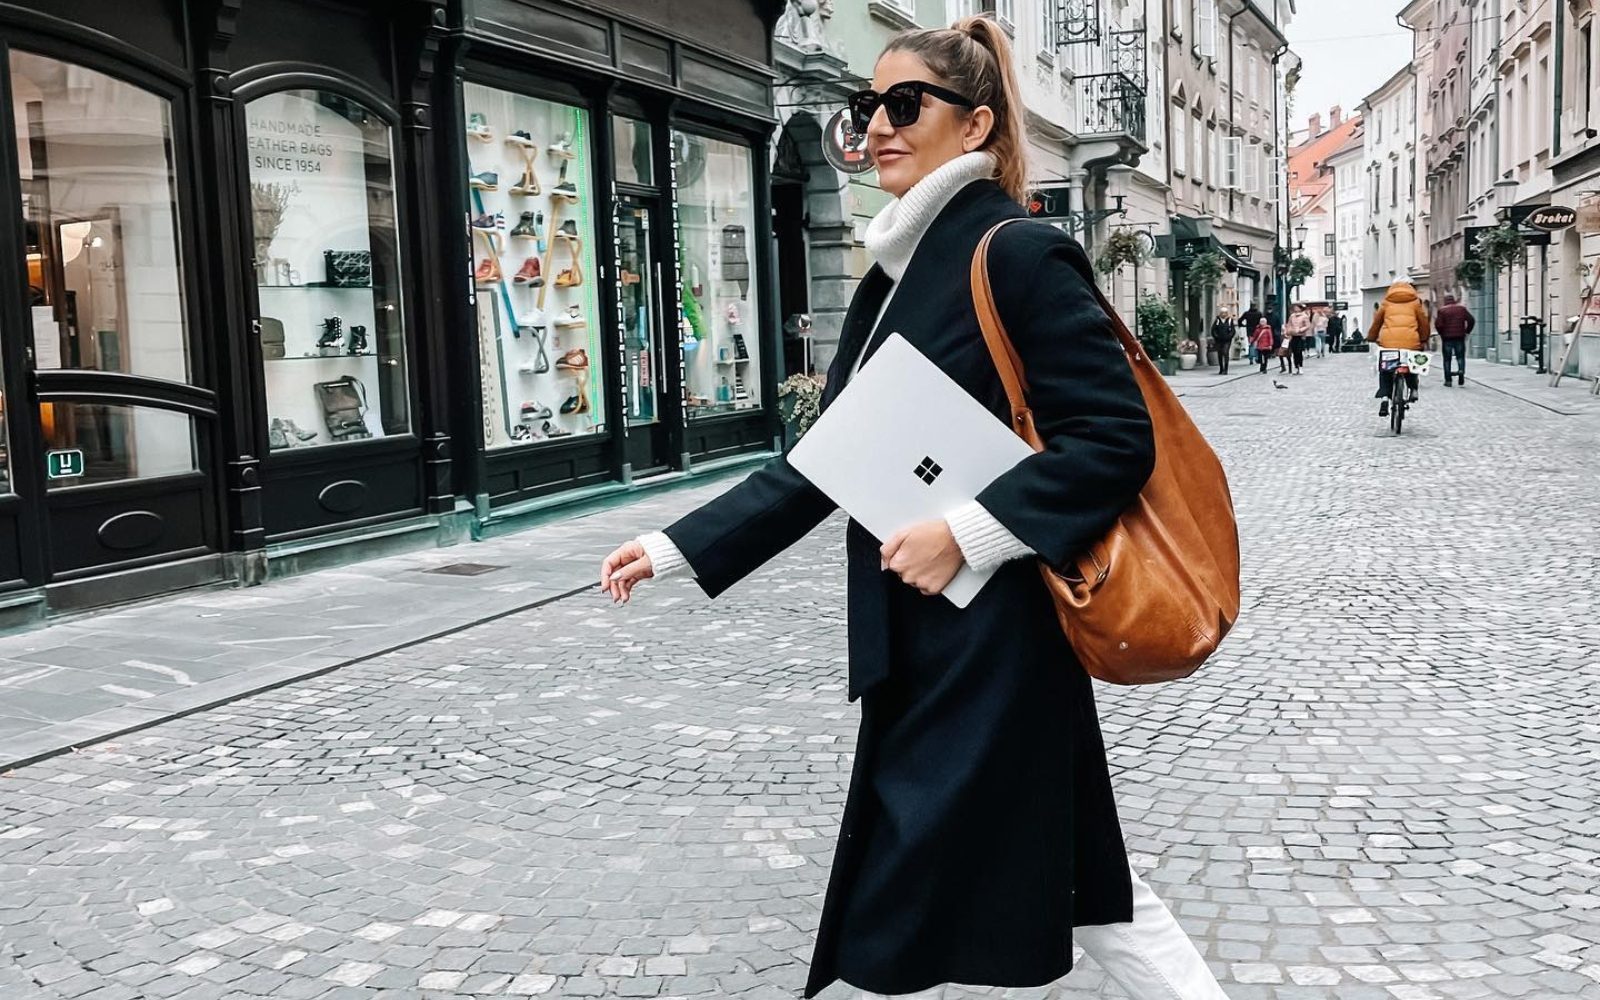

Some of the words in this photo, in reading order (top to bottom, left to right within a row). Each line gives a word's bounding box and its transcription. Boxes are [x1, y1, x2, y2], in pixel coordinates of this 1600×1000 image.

[250, 119, 321, 138] HANDMADE
[248, 136, 297, 153] EATHER
[301, 142, 333, 157] BAGS
[254, 155, 292, 171] SINCE
[295, 159, 321, 173] 1954
[1534, 212, 1575, 224] Brokat
